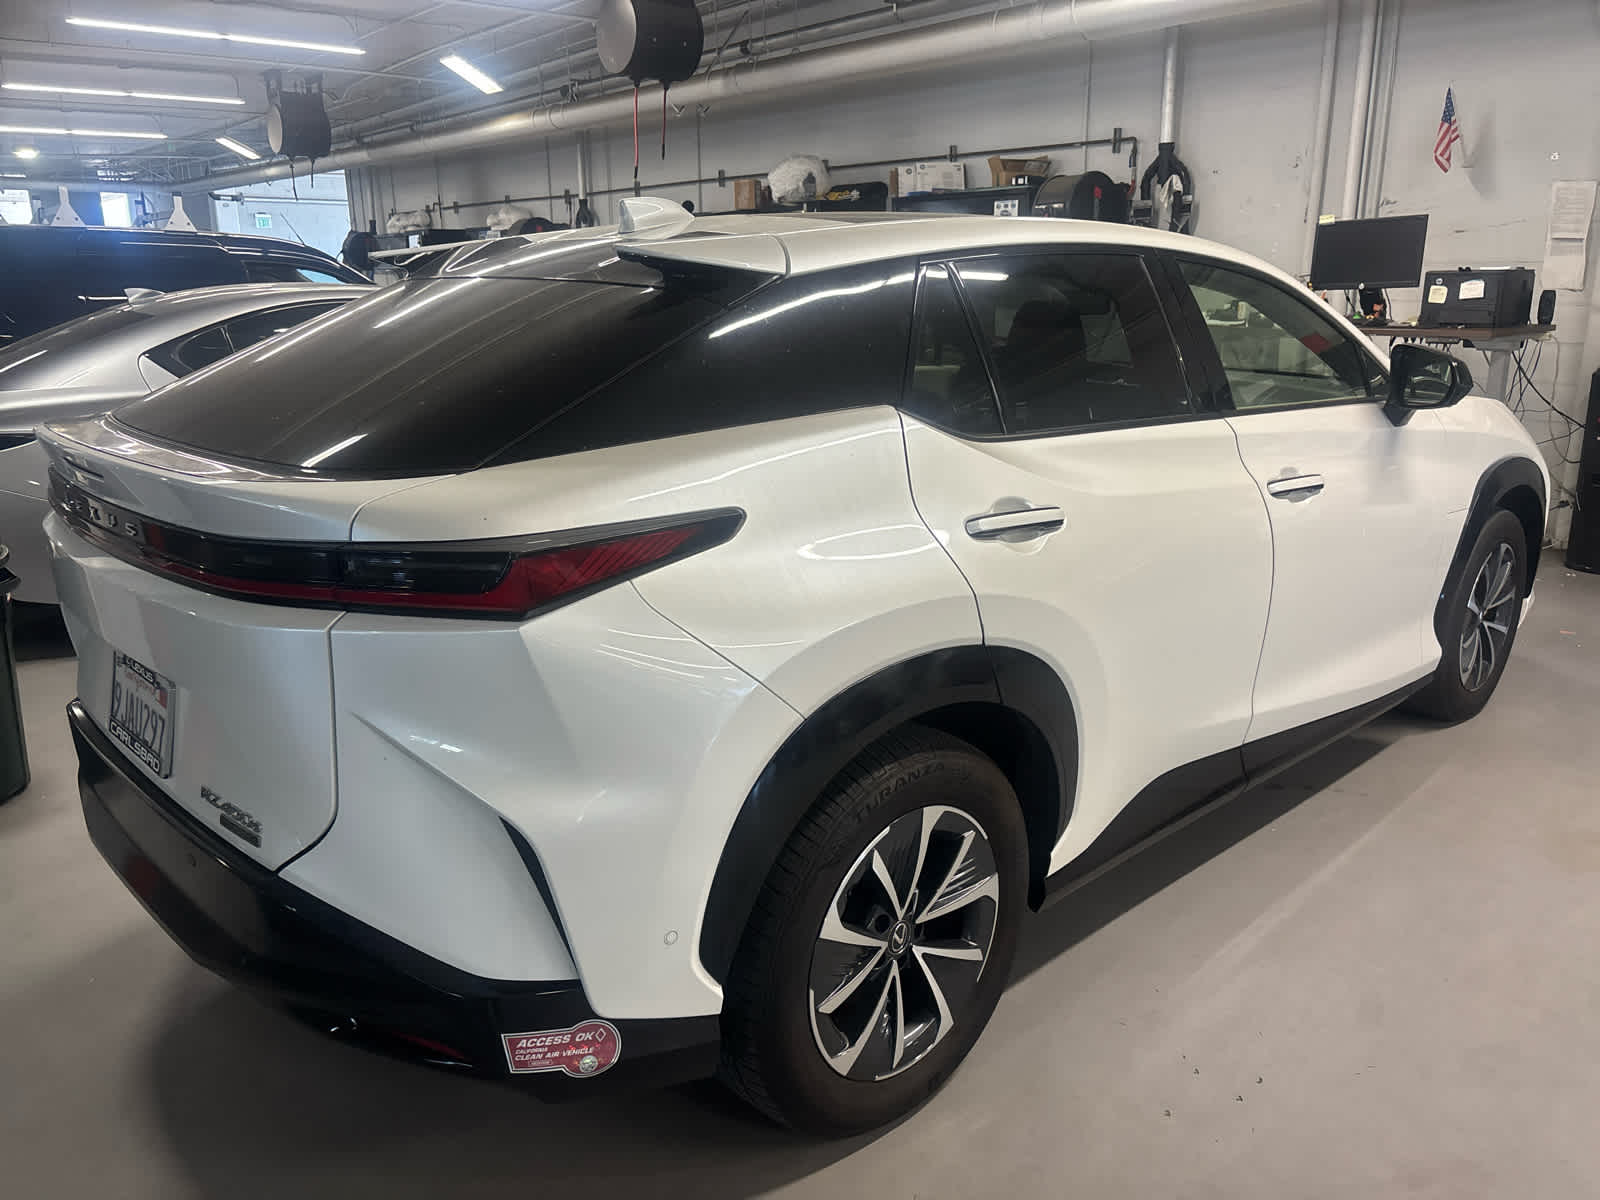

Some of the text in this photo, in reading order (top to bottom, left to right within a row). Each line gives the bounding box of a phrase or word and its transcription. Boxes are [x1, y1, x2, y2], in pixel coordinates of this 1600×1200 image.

[110, 720, 161, 774] CARLSBAD
[516, 1031, 596, 1048] ACCESS OK
[515, 1053, 543, 1061] CLEAN
[562, 1046, 595, 1057] VEHICLE
